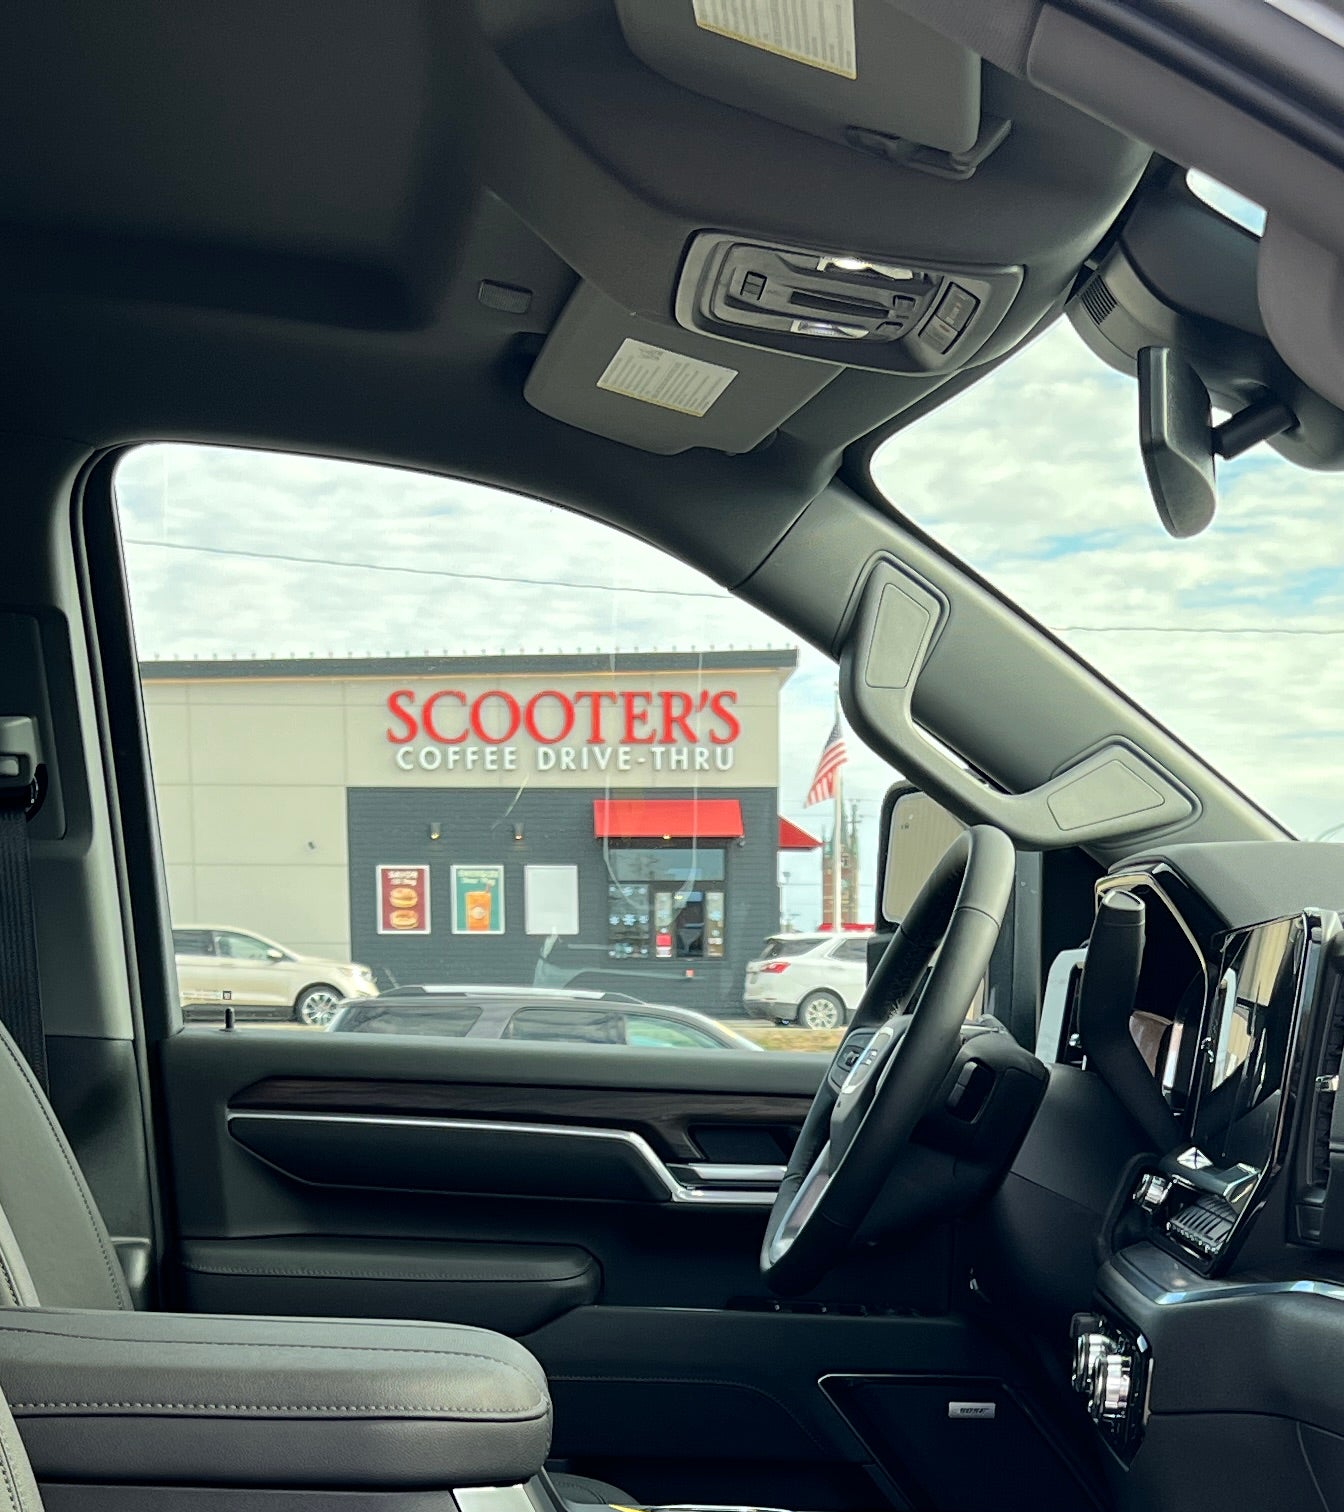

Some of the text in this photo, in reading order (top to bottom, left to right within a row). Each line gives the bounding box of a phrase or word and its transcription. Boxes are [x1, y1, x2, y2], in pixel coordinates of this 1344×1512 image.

[386, 689, 741, 745] SCOOTER'S
[396, 746, 734, 771] COFFEE DRIVE-THRU
